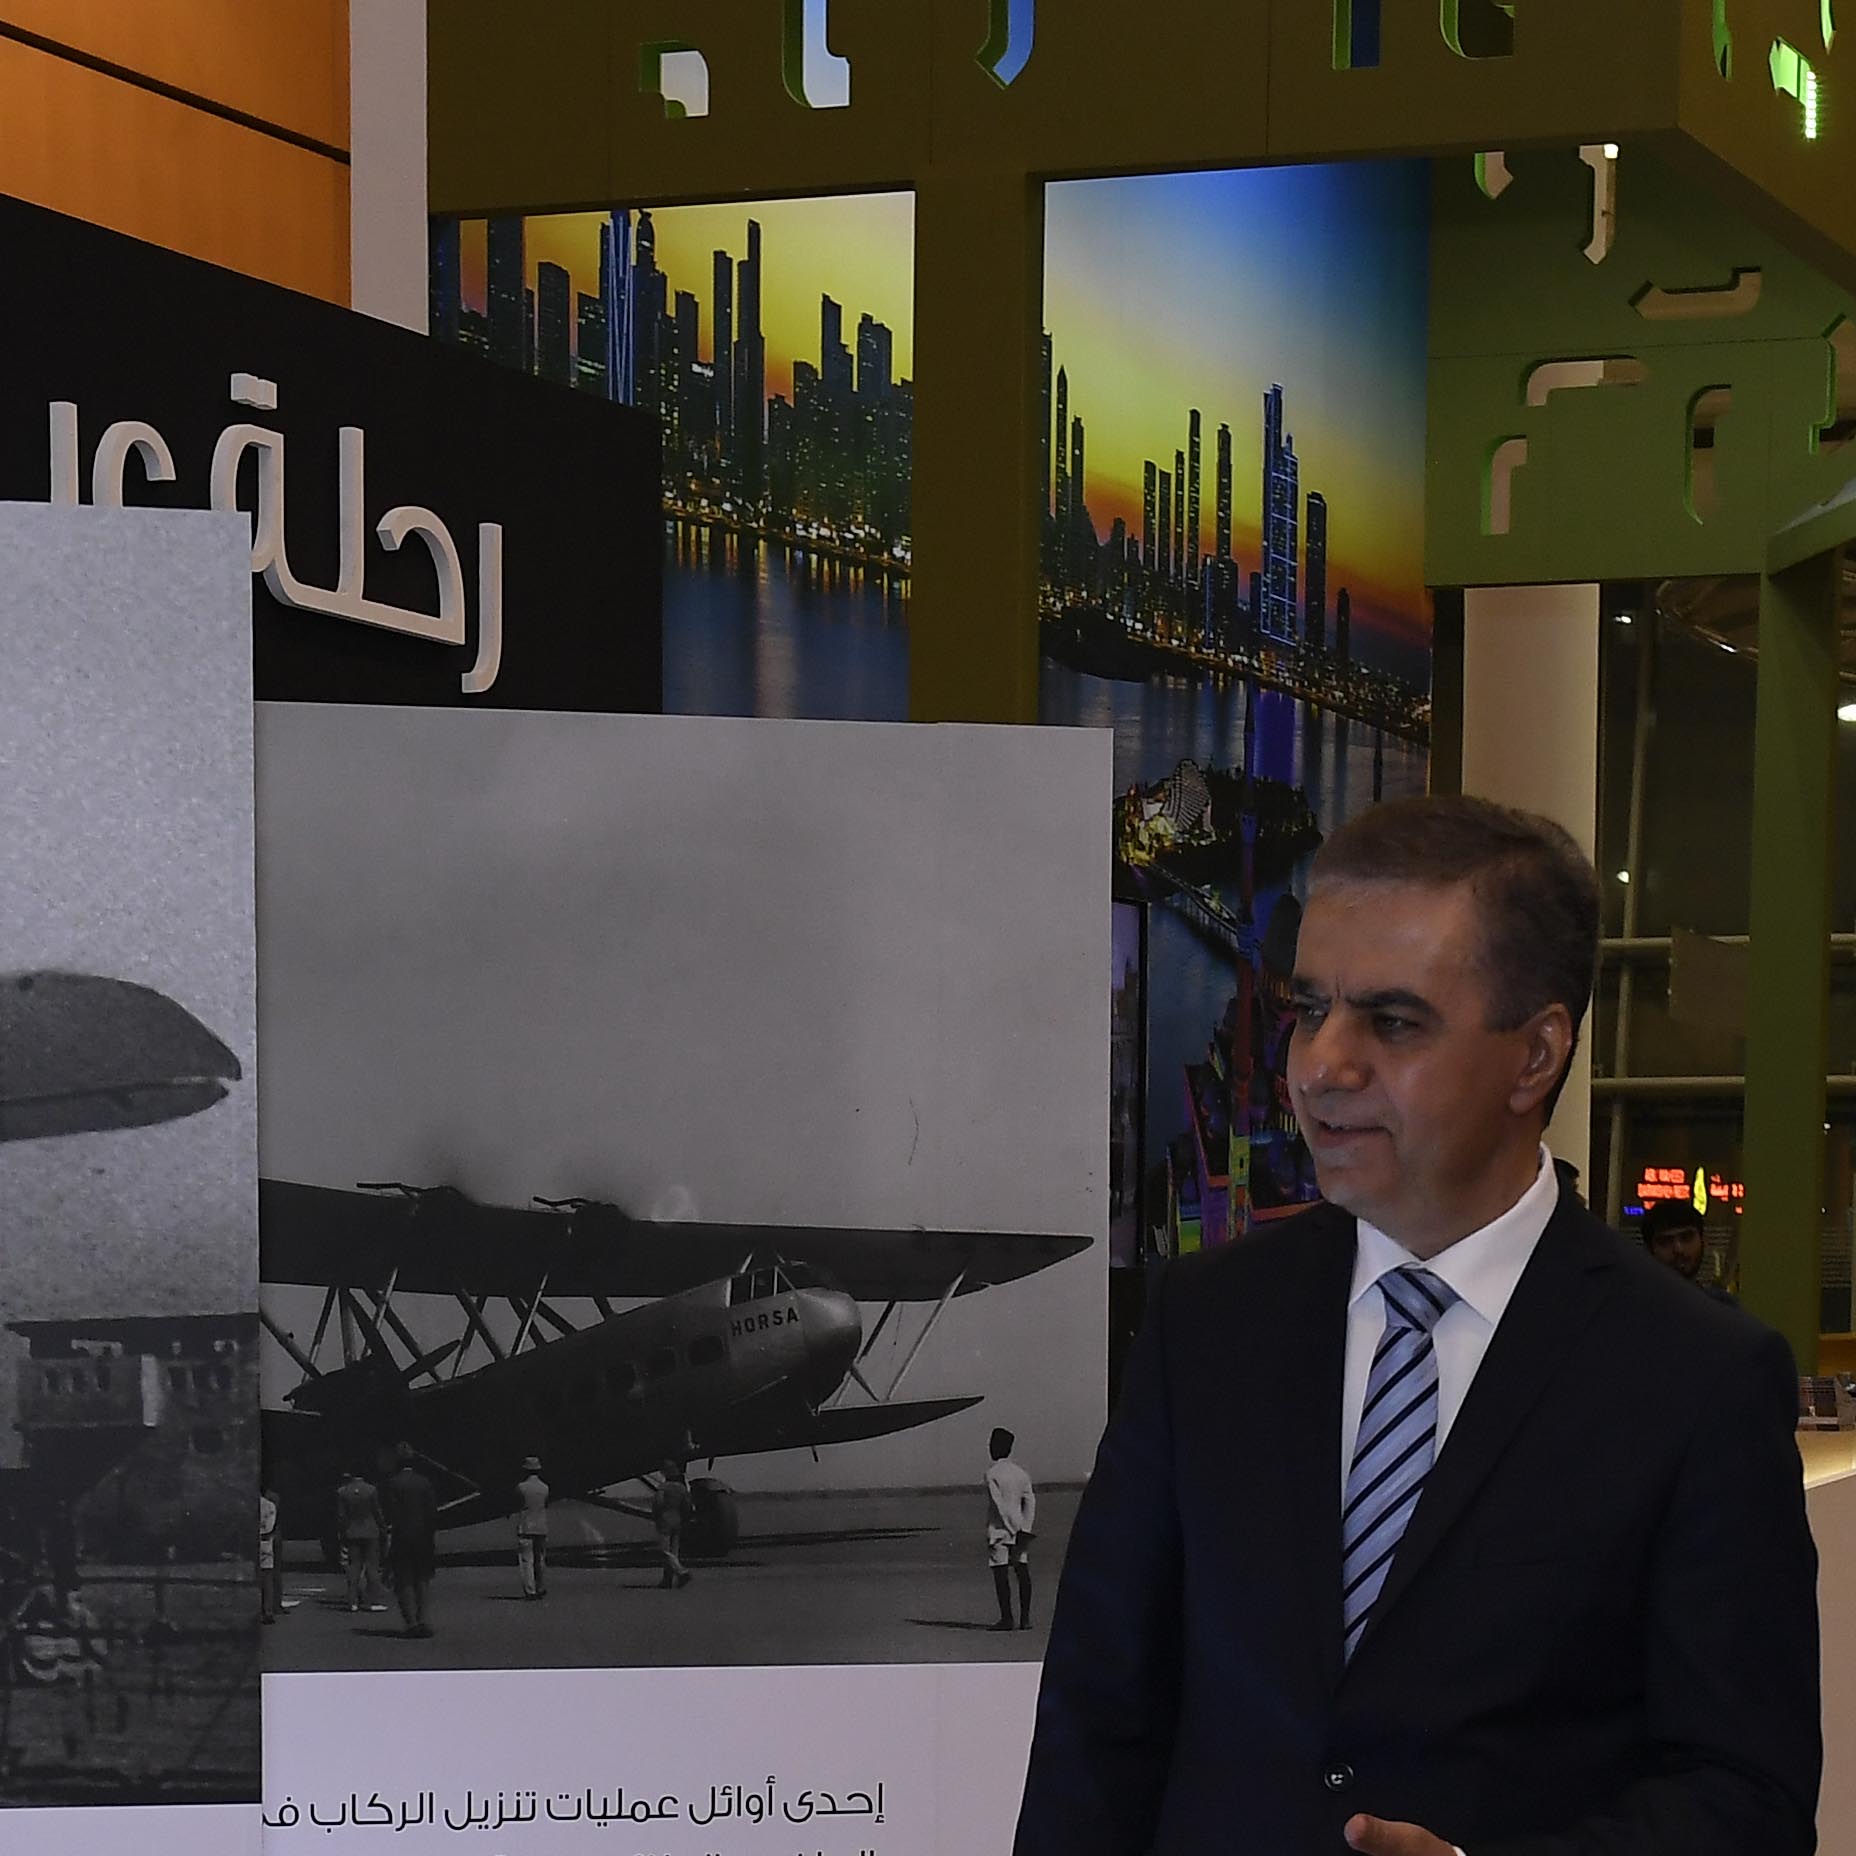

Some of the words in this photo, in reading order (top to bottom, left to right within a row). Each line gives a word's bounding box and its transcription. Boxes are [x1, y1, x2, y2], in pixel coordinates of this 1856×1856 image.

[209, 371, 503, 694] رحلة
[730, 1305, 800, 1339] HORSA
[310, 1791, 434, 1834] الركاب
[444, 1790, 537, 1831] تنزيل
[546, 1787, 679, 1828] عمليات
[688, 1775, 776, 1826] أوائل
[783, 1782, 885, 1824] إحدى
